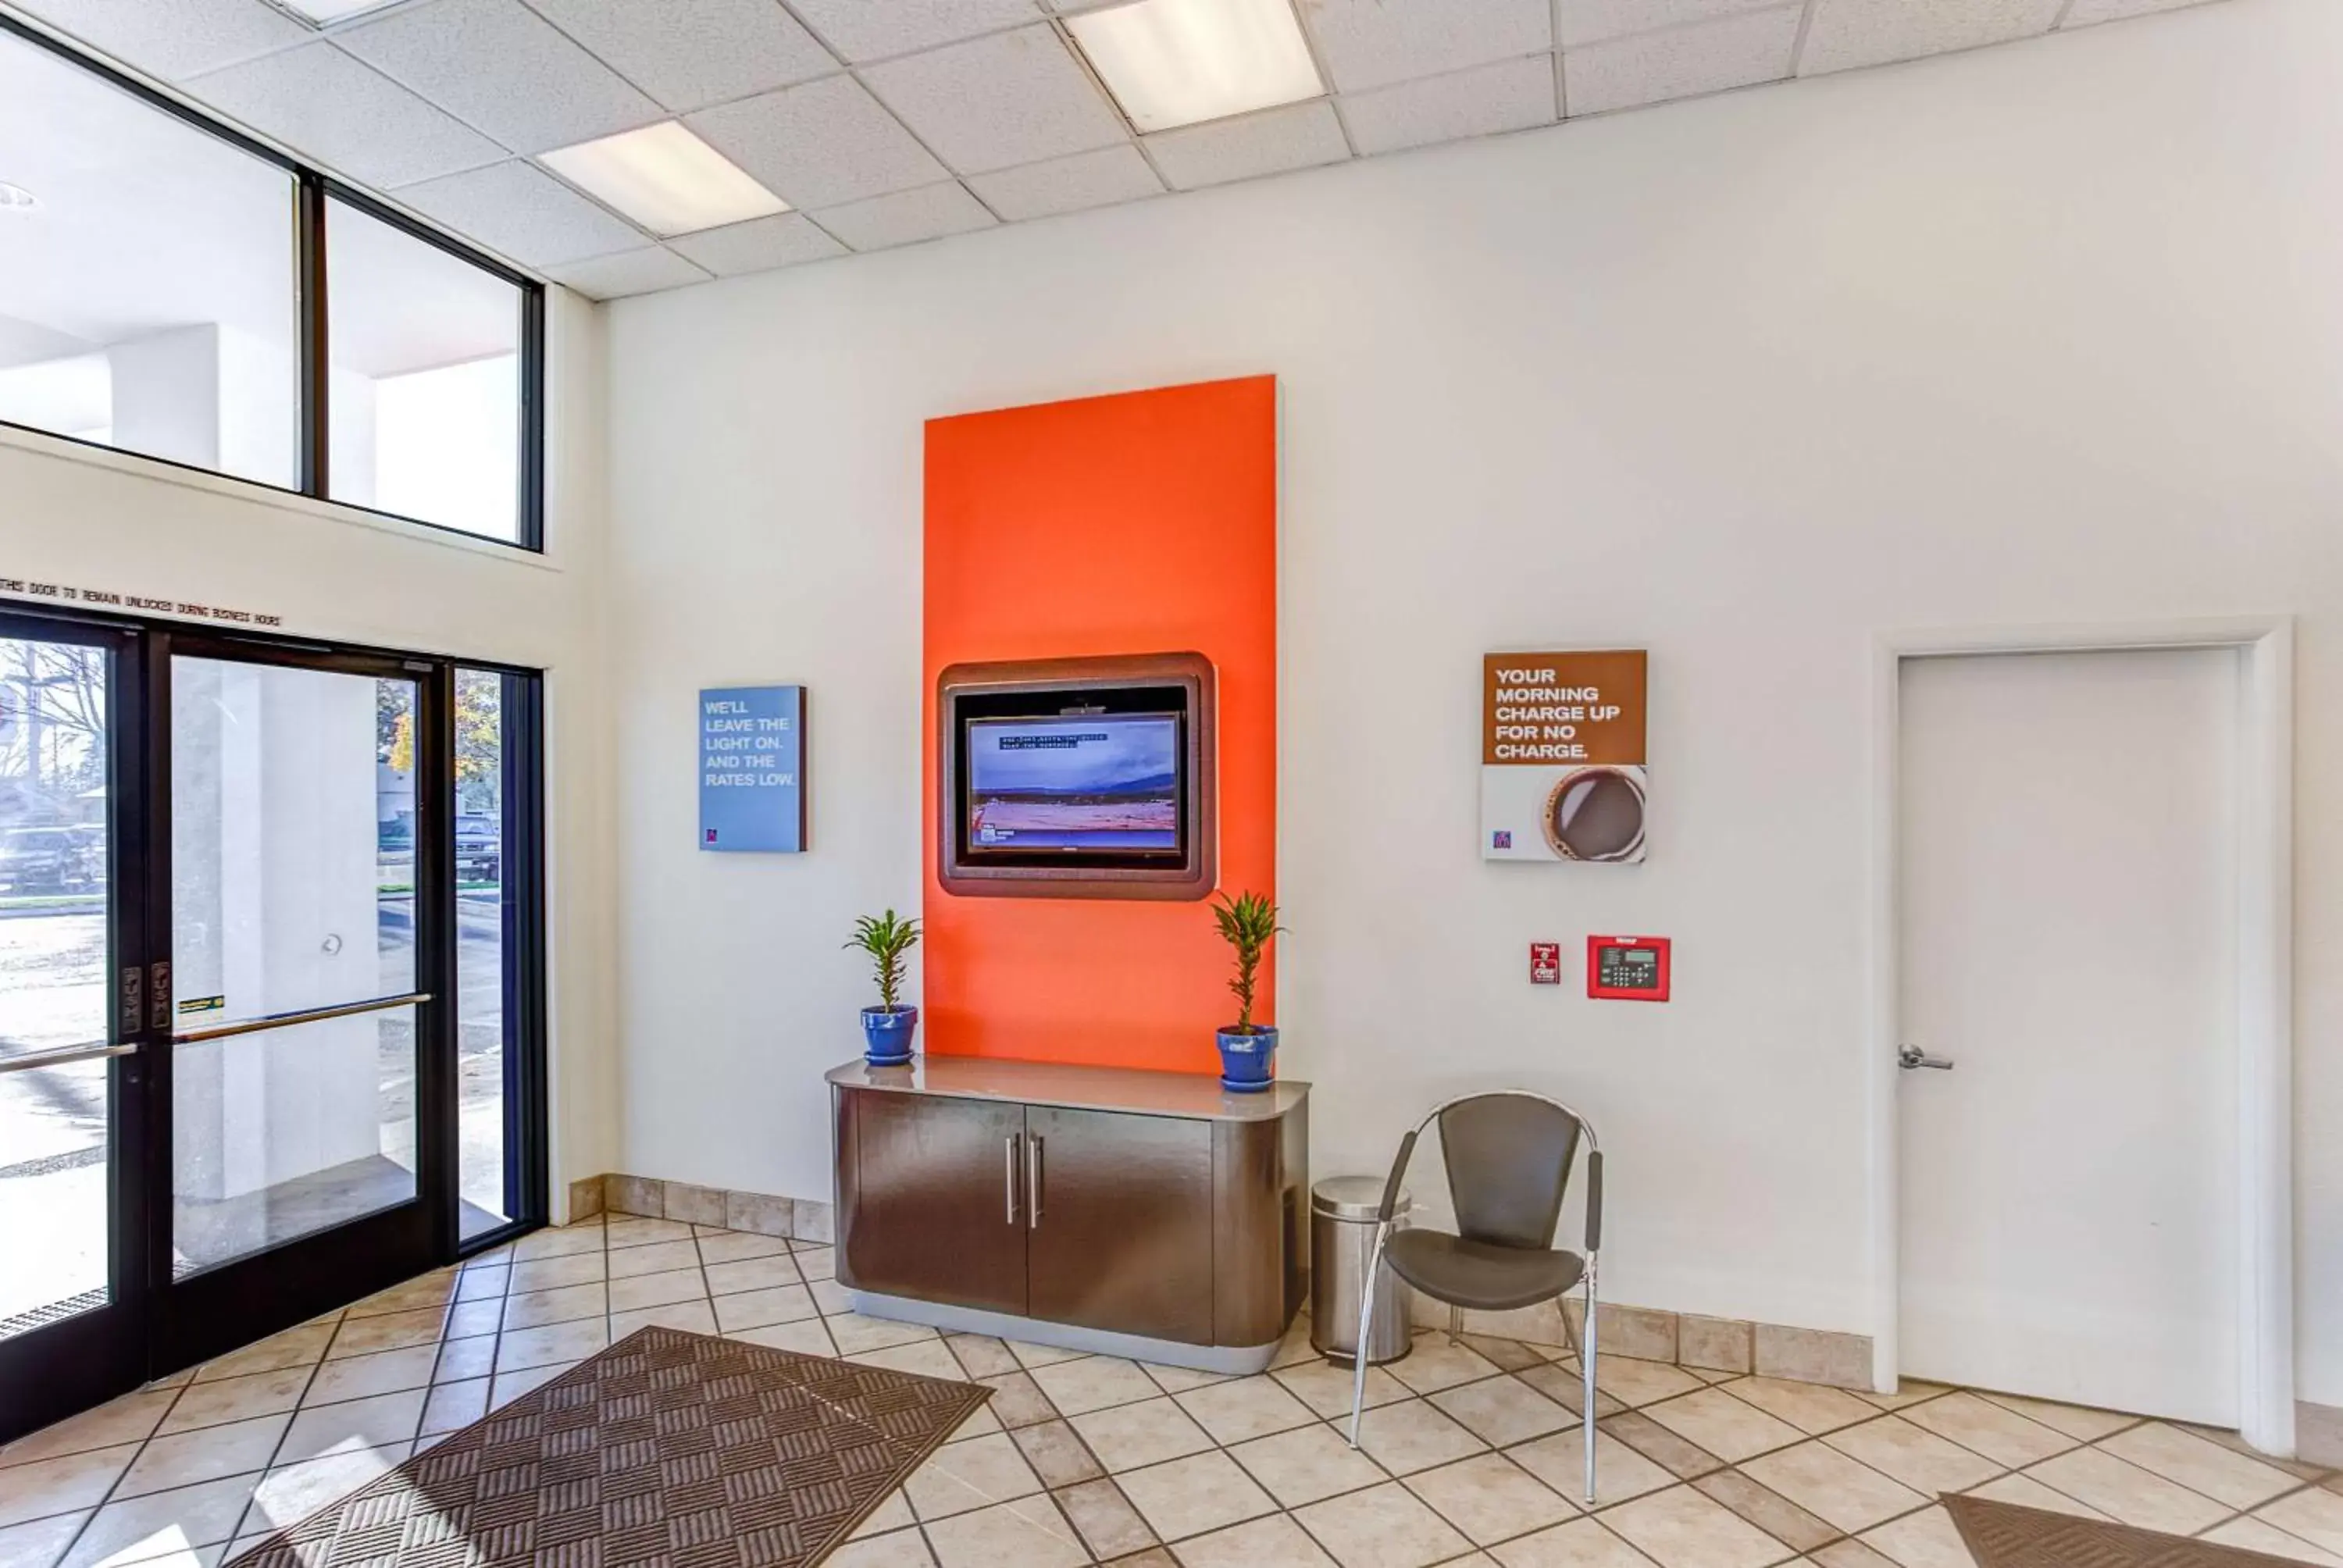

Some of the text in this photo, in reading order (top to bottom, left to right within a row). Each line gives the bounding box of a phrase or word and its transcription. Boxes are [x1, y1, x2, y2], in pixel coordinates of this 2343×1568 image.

[30, 583, 58, 597] DOOR
[63, 587, 77, 599] TO
[83, 590, 120, 604] REMAIN
[125, 595, 172, 611] UNLOCKED
[1495, 669, 1557, 684] YOUR
[1496, 687, 1599, 703] MORNING
[704, 700, 749, 715] WE'LL
[1495, 705, 1621, 722] CHARGE UP
[705, 717, 790, 732] LEAVE THE
[1496, 725, 1576, 740] FOR NO
[705, 736, 784, 750] LIGHT ON.
[1495, 744, 1589, 759] CHARGE.
[706, 755, 776, 769] AND THE
[705, 773, 796, 787] RATES LOW.
